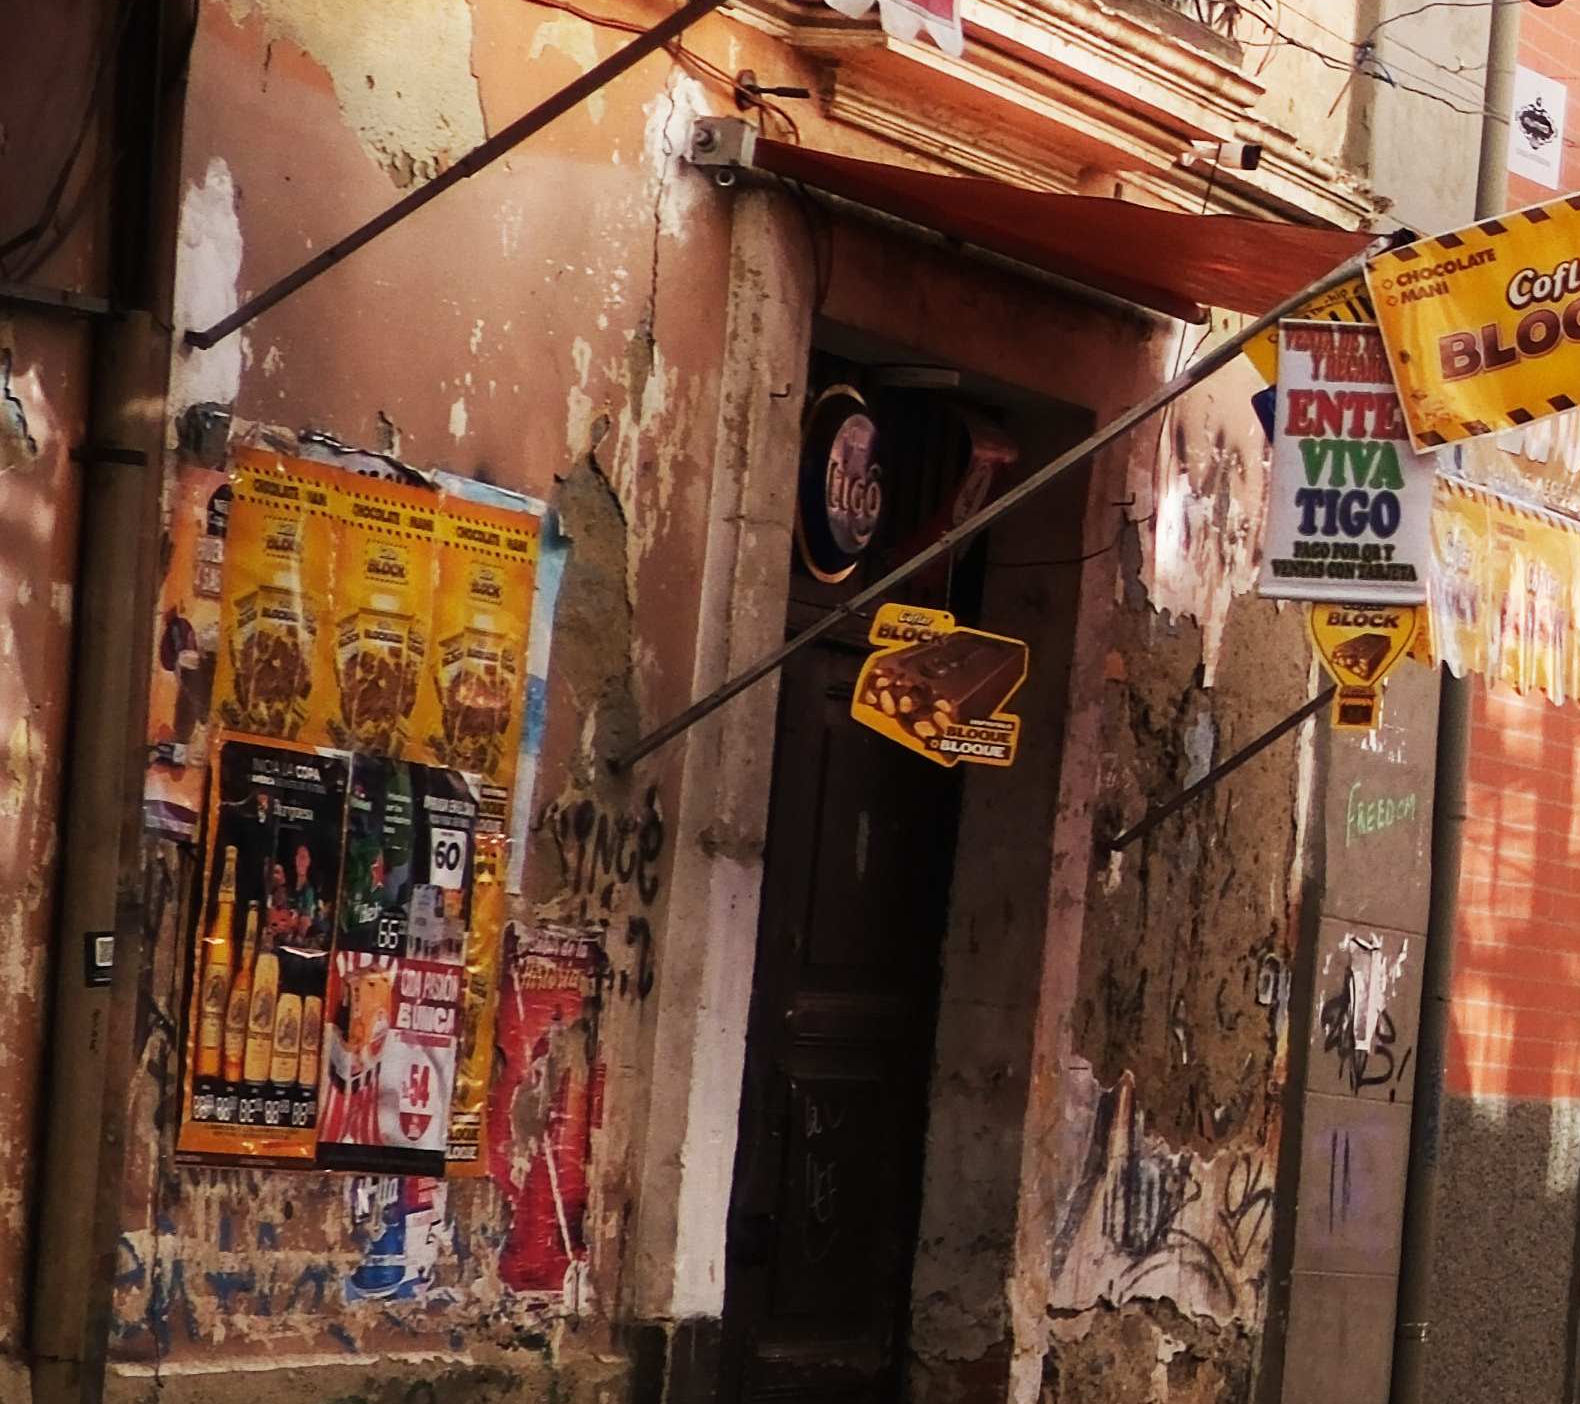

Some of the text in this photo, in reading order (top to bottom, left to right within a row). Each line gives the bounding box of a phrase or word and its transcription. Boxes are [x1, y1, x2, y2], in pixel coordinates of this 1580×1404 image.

[1395, 247, 1497, 289] CHOCOLATE
[1299, 440, 1406, 489] VIVA
[1294, 487, 1401, 538] TIGO
[1326, 560, 1355, 580] CON
[877, 623, 949, 645] BLOCK
[1326, 610, 1400, 629] BLOCK
[939, 738, 1006, 759] BLOQUE
[1346, 781, 1417, 849] FREEDOM
[434, 840, 461, 872] 60
